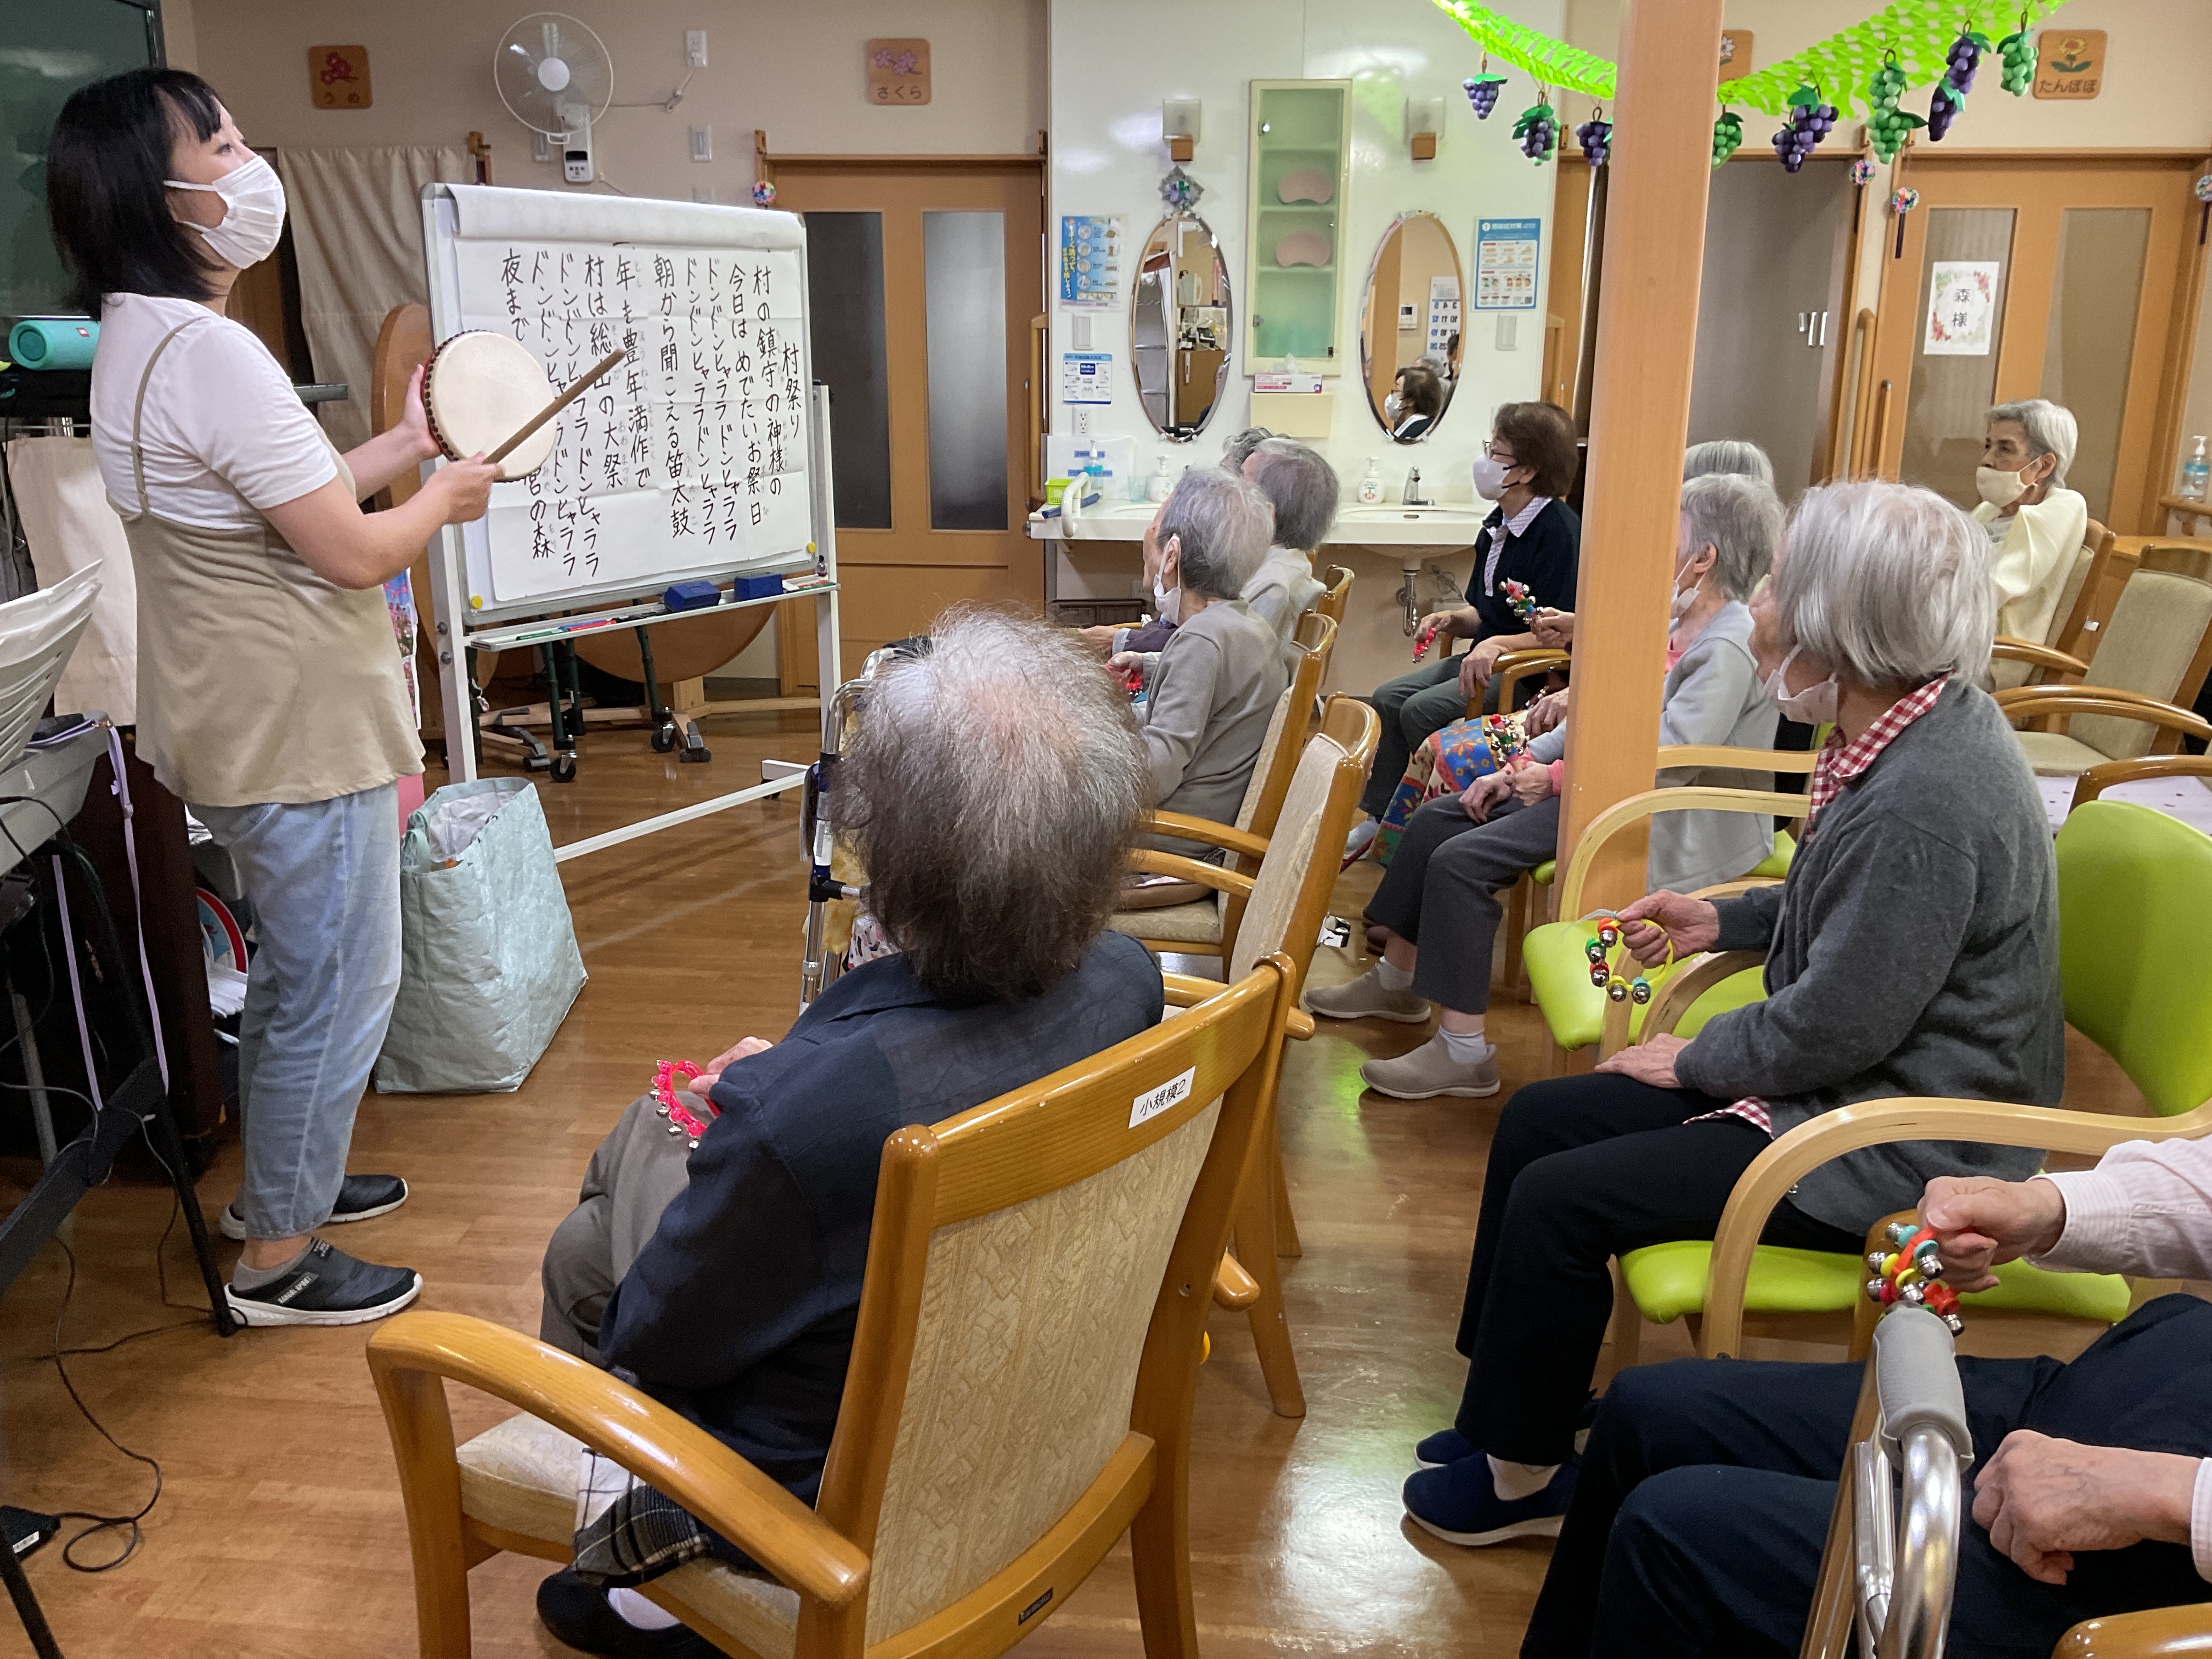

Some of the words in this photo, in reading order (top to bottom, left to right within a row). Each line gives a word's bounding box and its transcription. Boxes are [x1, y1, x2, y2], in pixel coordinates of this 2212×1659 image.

[324, 91, 360, 105] うめ
[877, 86, 922, 99] さくら
[2039, 78, 2098, 93] たんぽぽ
[501, 248, 530, 341] 夜まで
[1953, 287, 1971, 328] 森様
[654, 253, 695, 539] 朝から聞こえる笛太鼓
[753, 266, 785, 495] 村の鎮守の神様の
[782, 342, 802, 438] 村祭り
[1139, 1079, 1186, 1116] 小規模2
